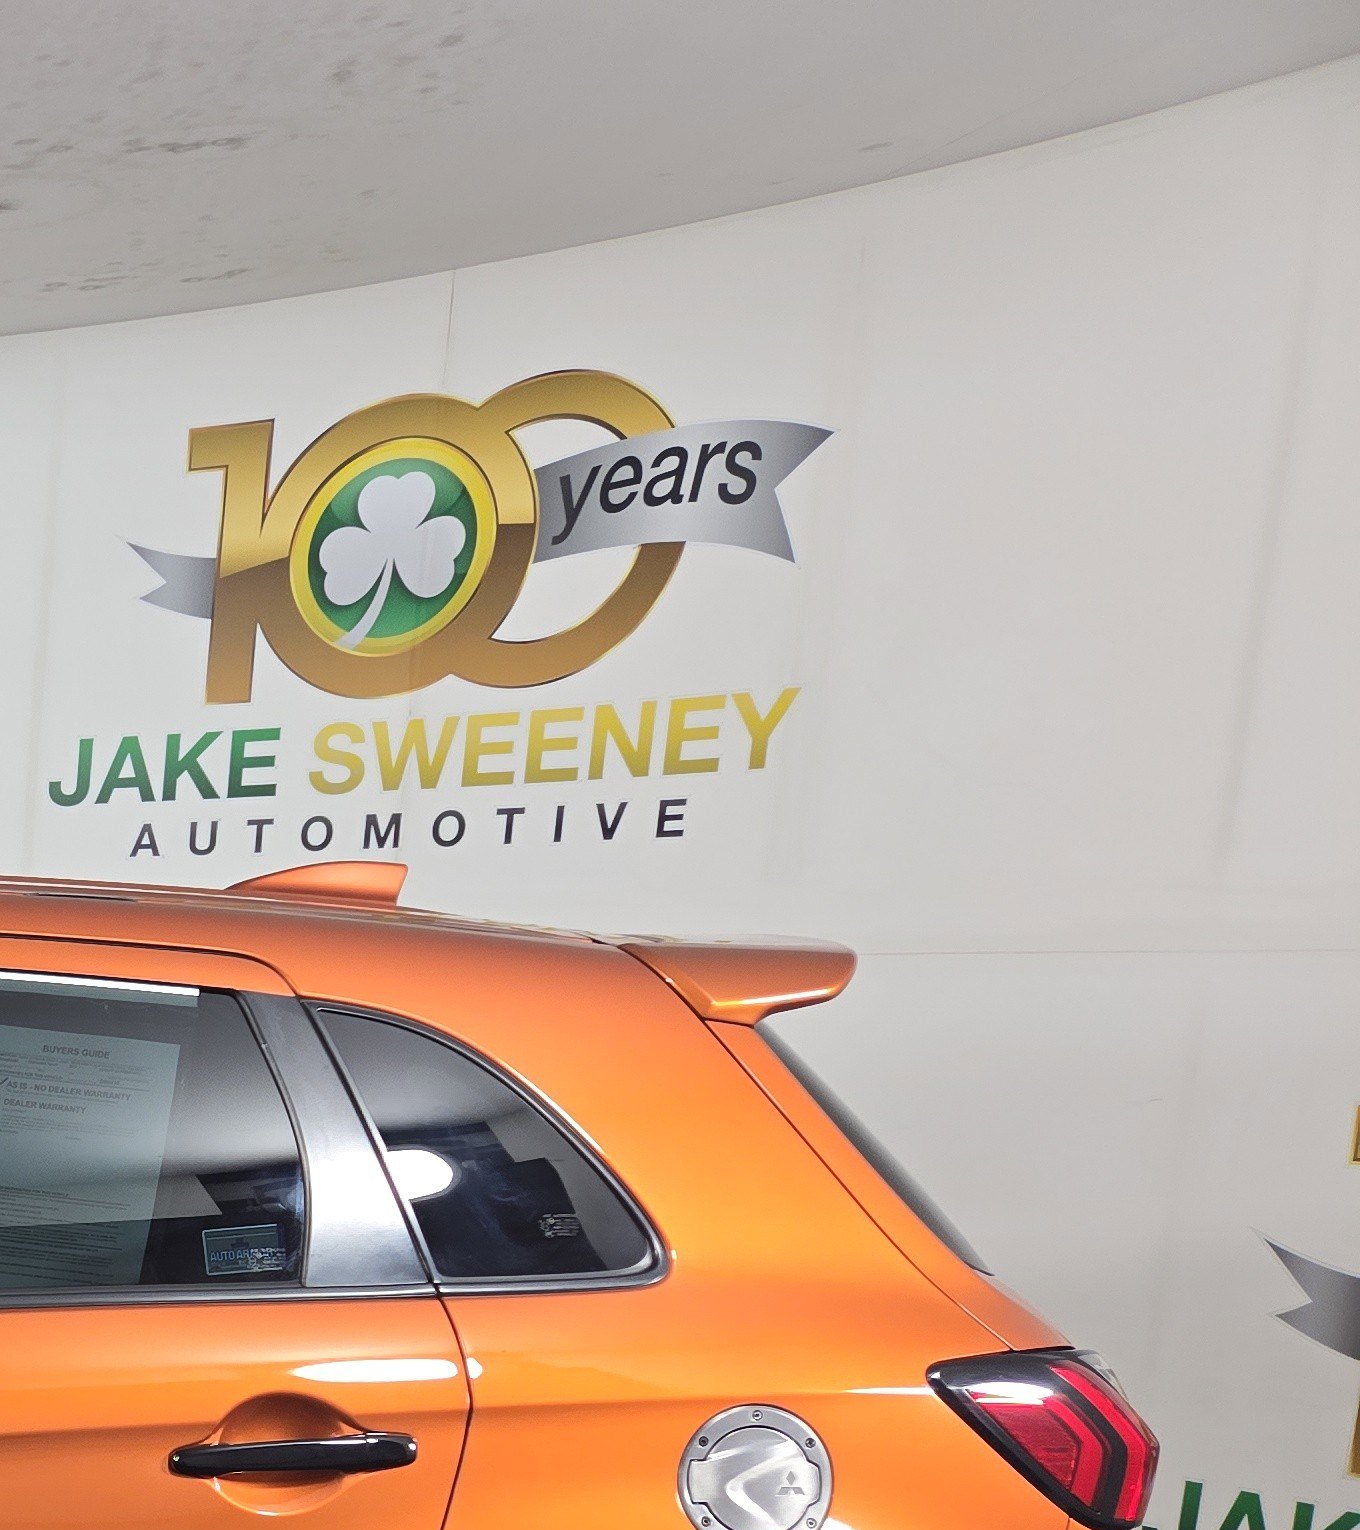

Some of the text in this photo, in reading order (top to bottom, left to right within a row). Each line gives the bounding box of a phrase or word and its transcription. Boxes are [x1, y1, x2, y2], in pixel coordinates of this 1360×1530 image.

[187, 368, 762, 705] 100 years
[47, 687, 801, 808] JAKE SWEENEY
[129, 798, 688, 858] AUTOMOTIVE
[42, 1044, 111, 1060] BUYERS GUIDE
[7, 1080, 19, 1089] AS
[20, 1081, 28, 1090] IS
[33, 1083, 47, 1092] NO
[48, 1085, 82, 1096] DEALER
[83, 1089, 132, 1100] WARRANTY
[3, 1098, 87, 1114] DEALER WARRANTY
[210, 1250, 235, 1262] AUTO
